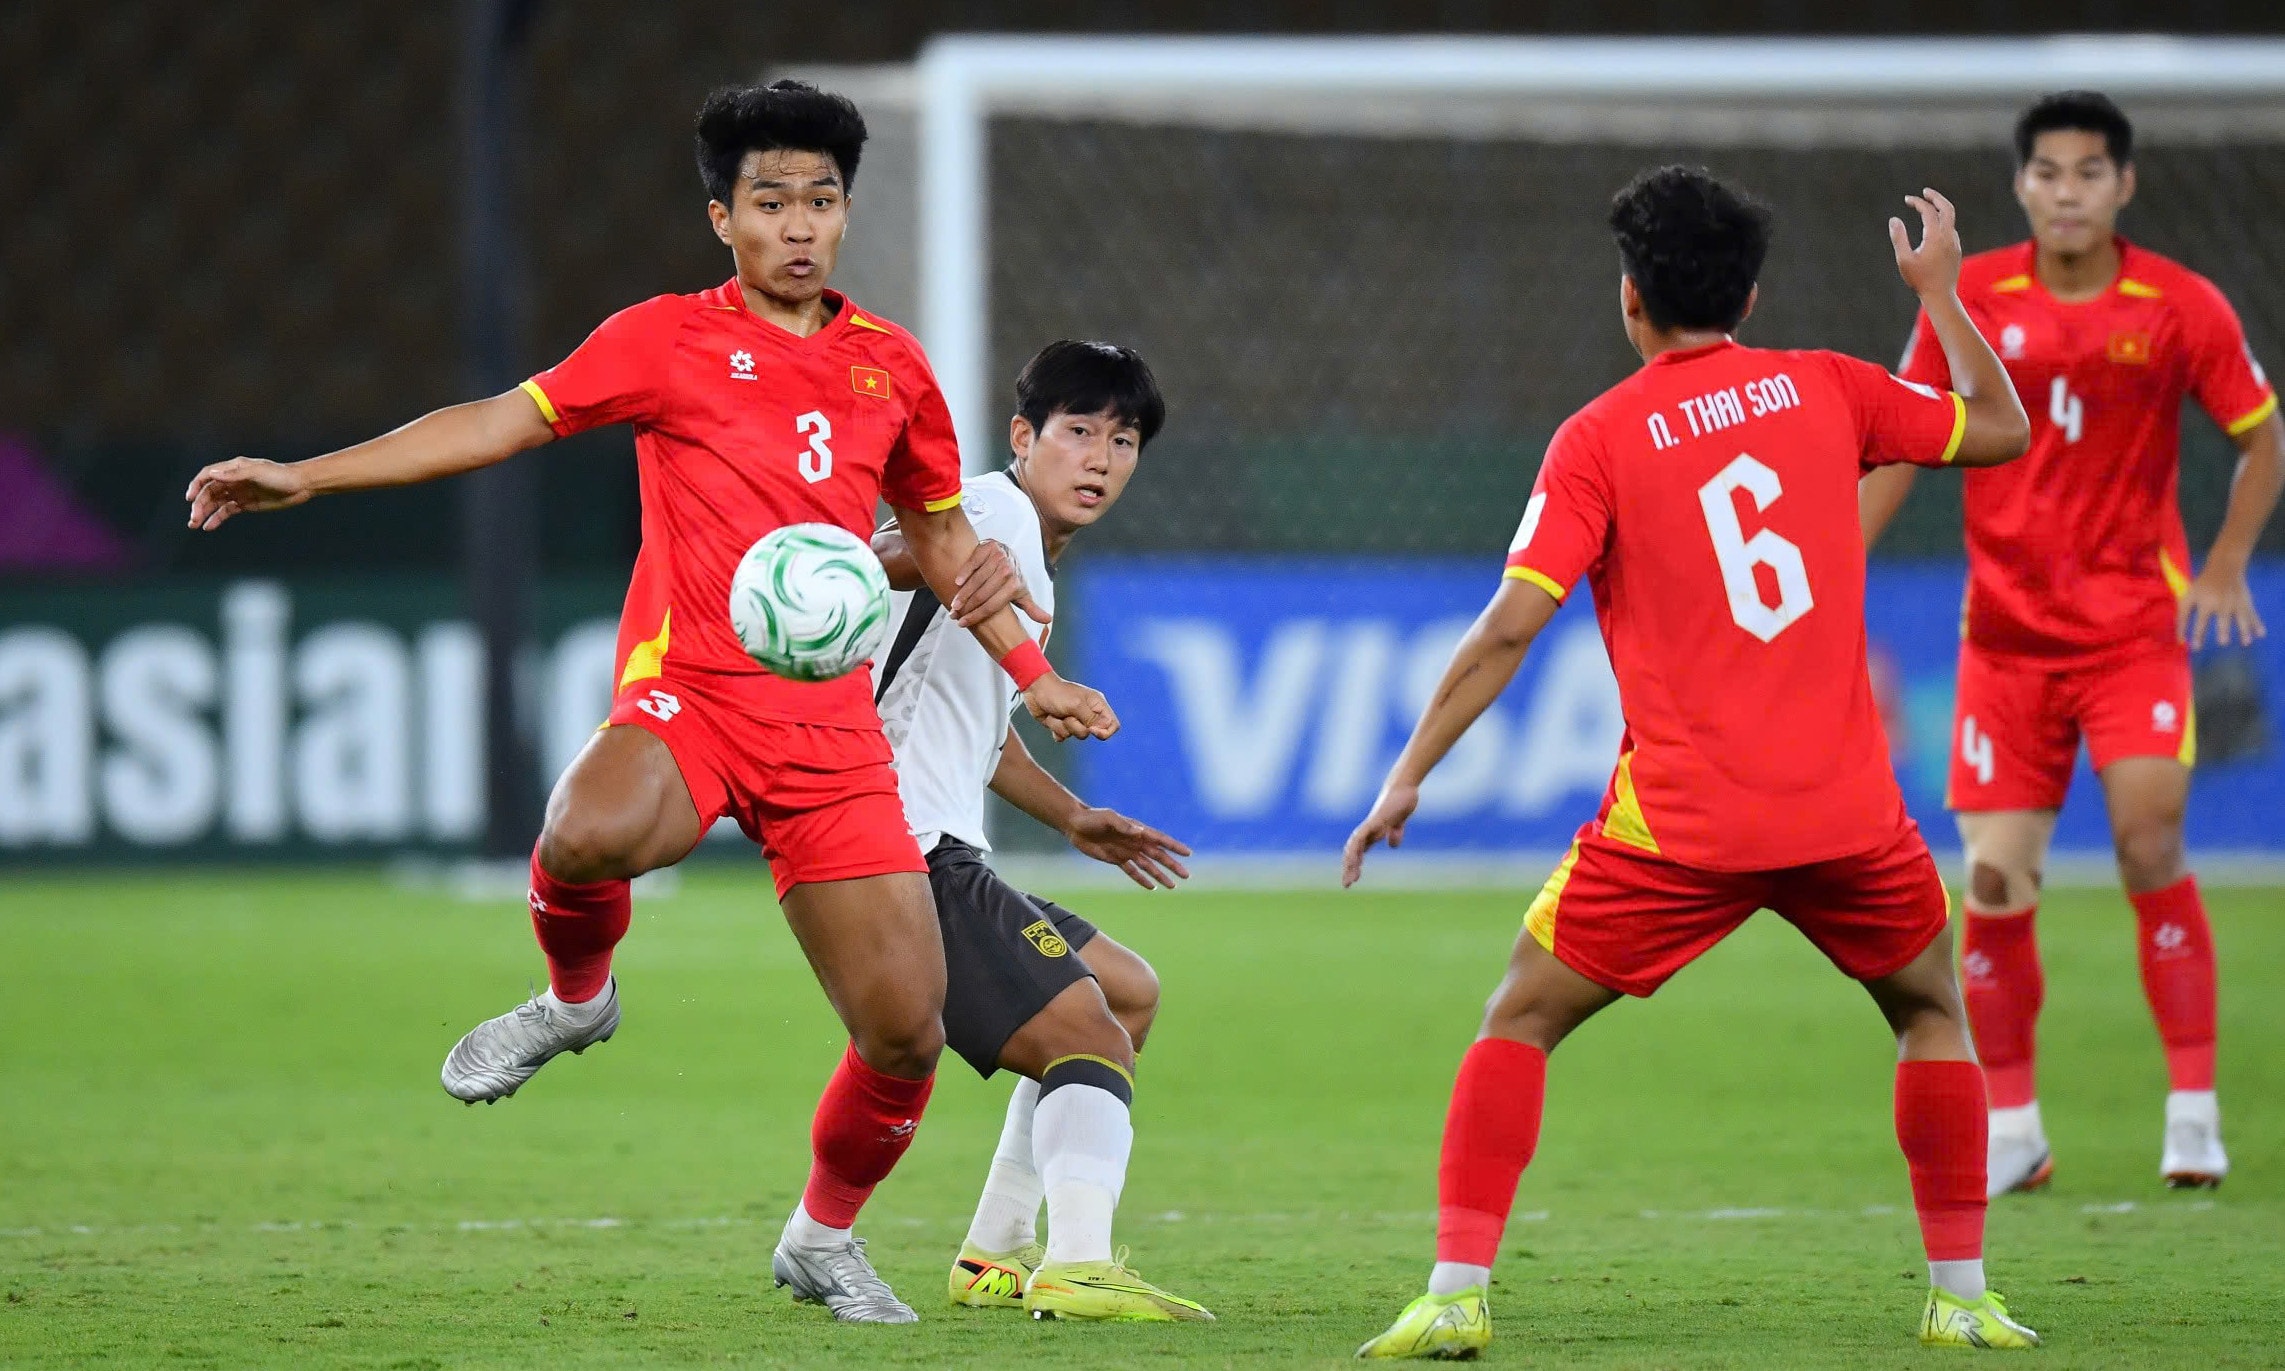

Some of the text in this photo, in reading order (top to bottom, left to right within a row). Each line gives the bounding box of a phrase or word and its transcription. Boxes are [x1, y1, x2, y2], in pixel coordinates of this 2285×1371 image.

[1678, 386, 1746, 438] THAI
[1745, 372, 1801, 418] SON
[2049, 376, 2083, 444] 4
[796, 410, 832, 484] 3
[1697, 452, 1814, 643] 6
[636, 689, 682, 723] 3
[1962, 715, 1994, 785] 4
